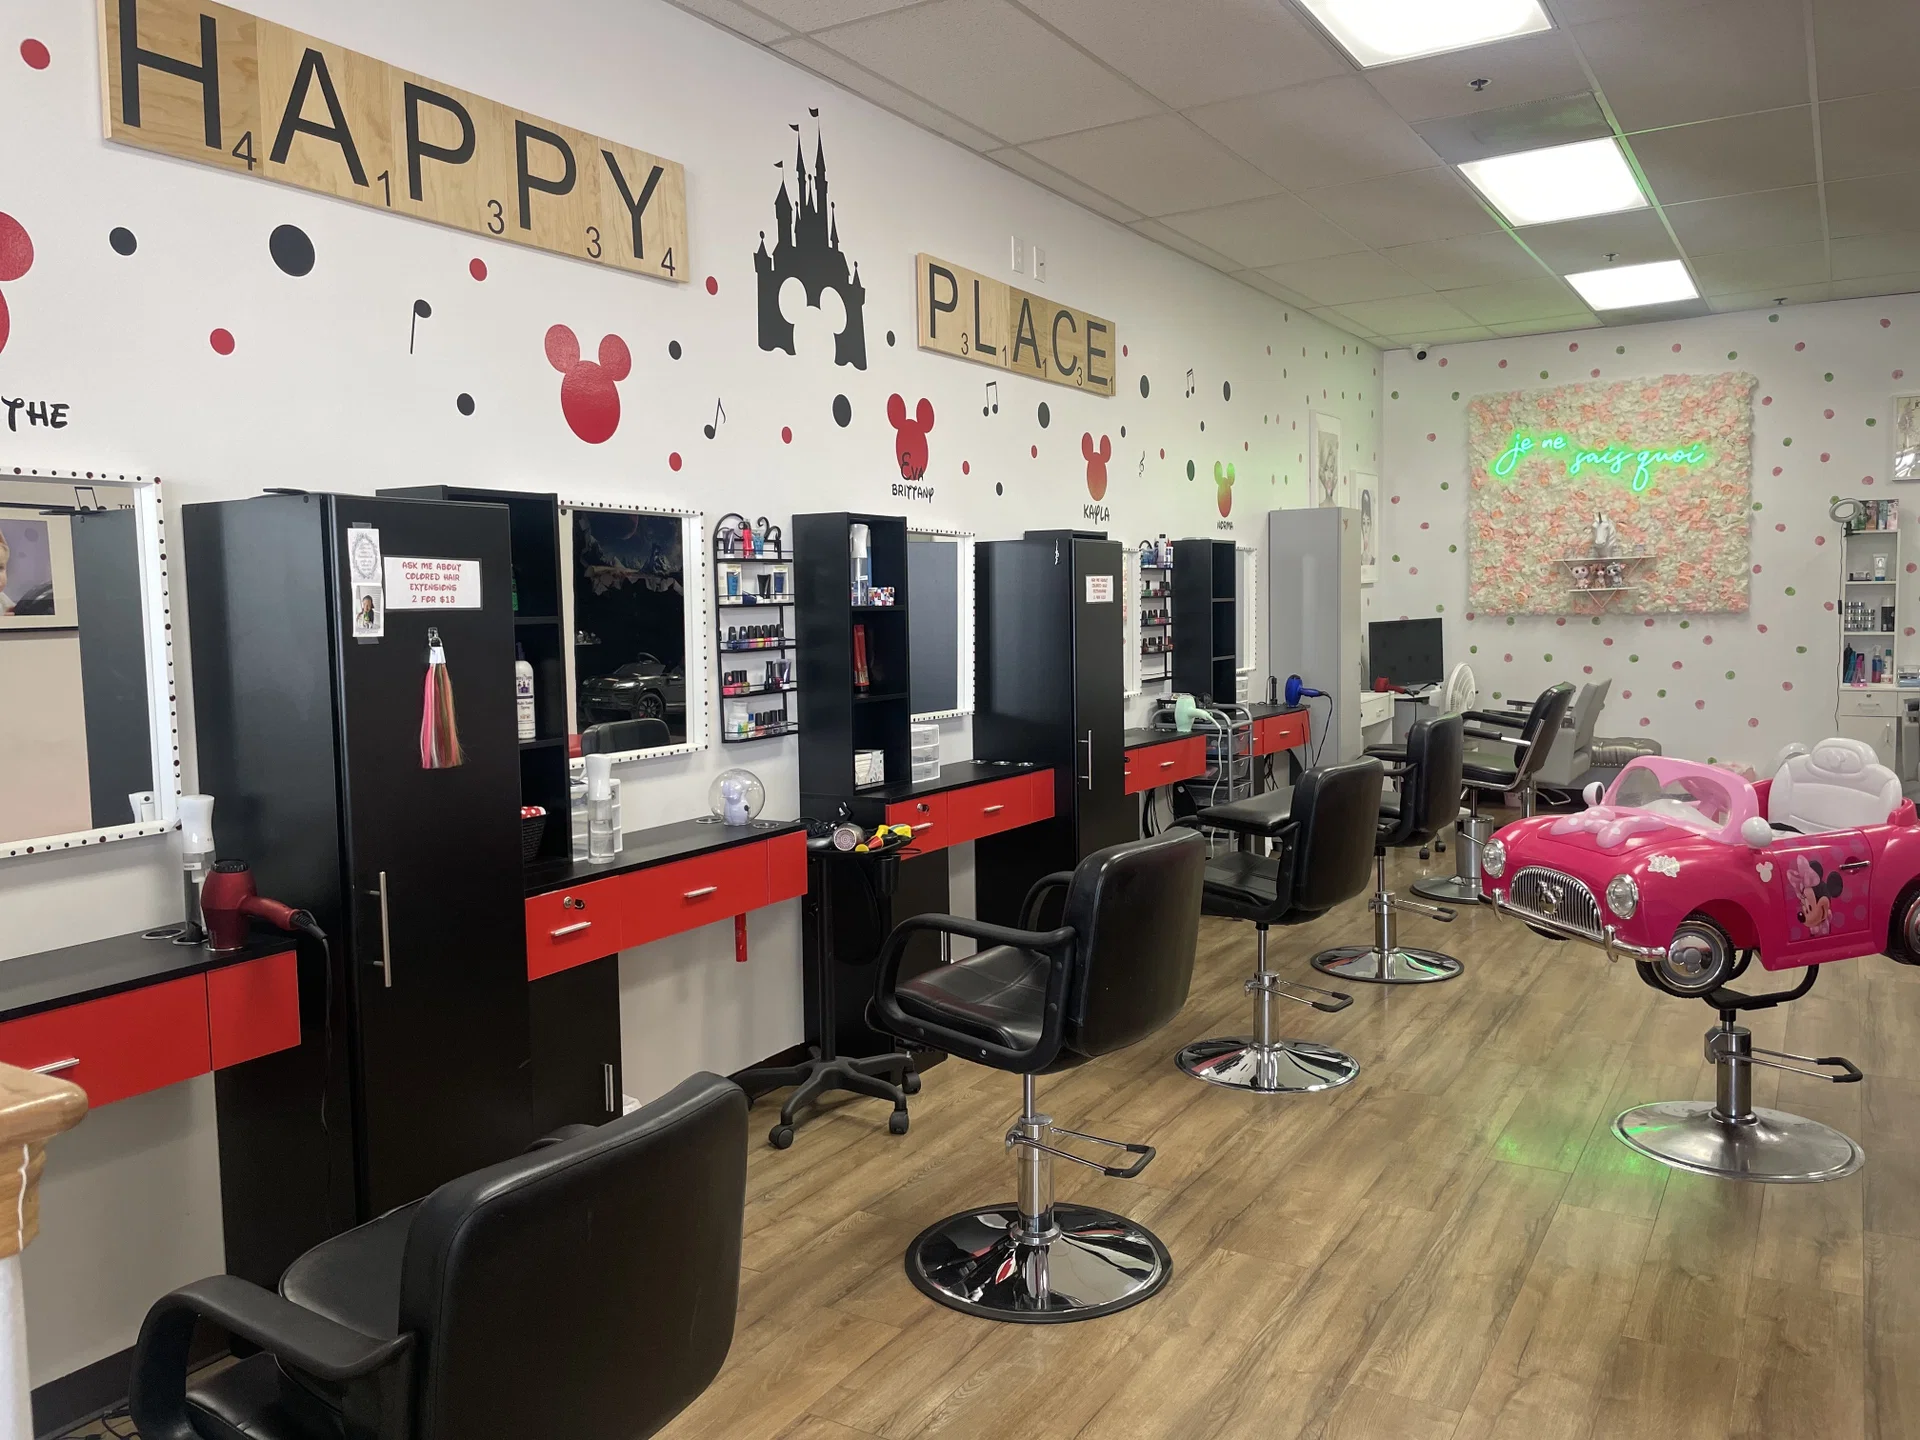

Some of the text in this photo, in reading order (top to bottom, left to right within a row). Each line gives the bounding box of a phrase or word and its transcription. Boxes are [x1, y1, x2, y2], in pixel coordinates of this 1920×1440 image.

[119, 0, 664, 260] HAPPY
[232, 131, 257, 170] 4
[487, 200, 503, 234] 3
[586, 227, 601, 259] 3
[661, 247, 675, 276] 4
[929, 263, 1107, 386] PLACE
[1, 396, 70, 432] THE
[1495, 434, 1567, 475] je ne
[1570, 444, 1705, 492] sais quoi
[891, 483, 935, 504] BRITTANY
[1083, 504, 1110, 525] KAYLA
[402, 561, 462, 572] ASK ME ABOUT
[405, 572, 460, 581] COLORED HAIR
[409, 583, 457, 592] EXTENSIONS
[412, 595, 456, 604] 2 FOR $18
